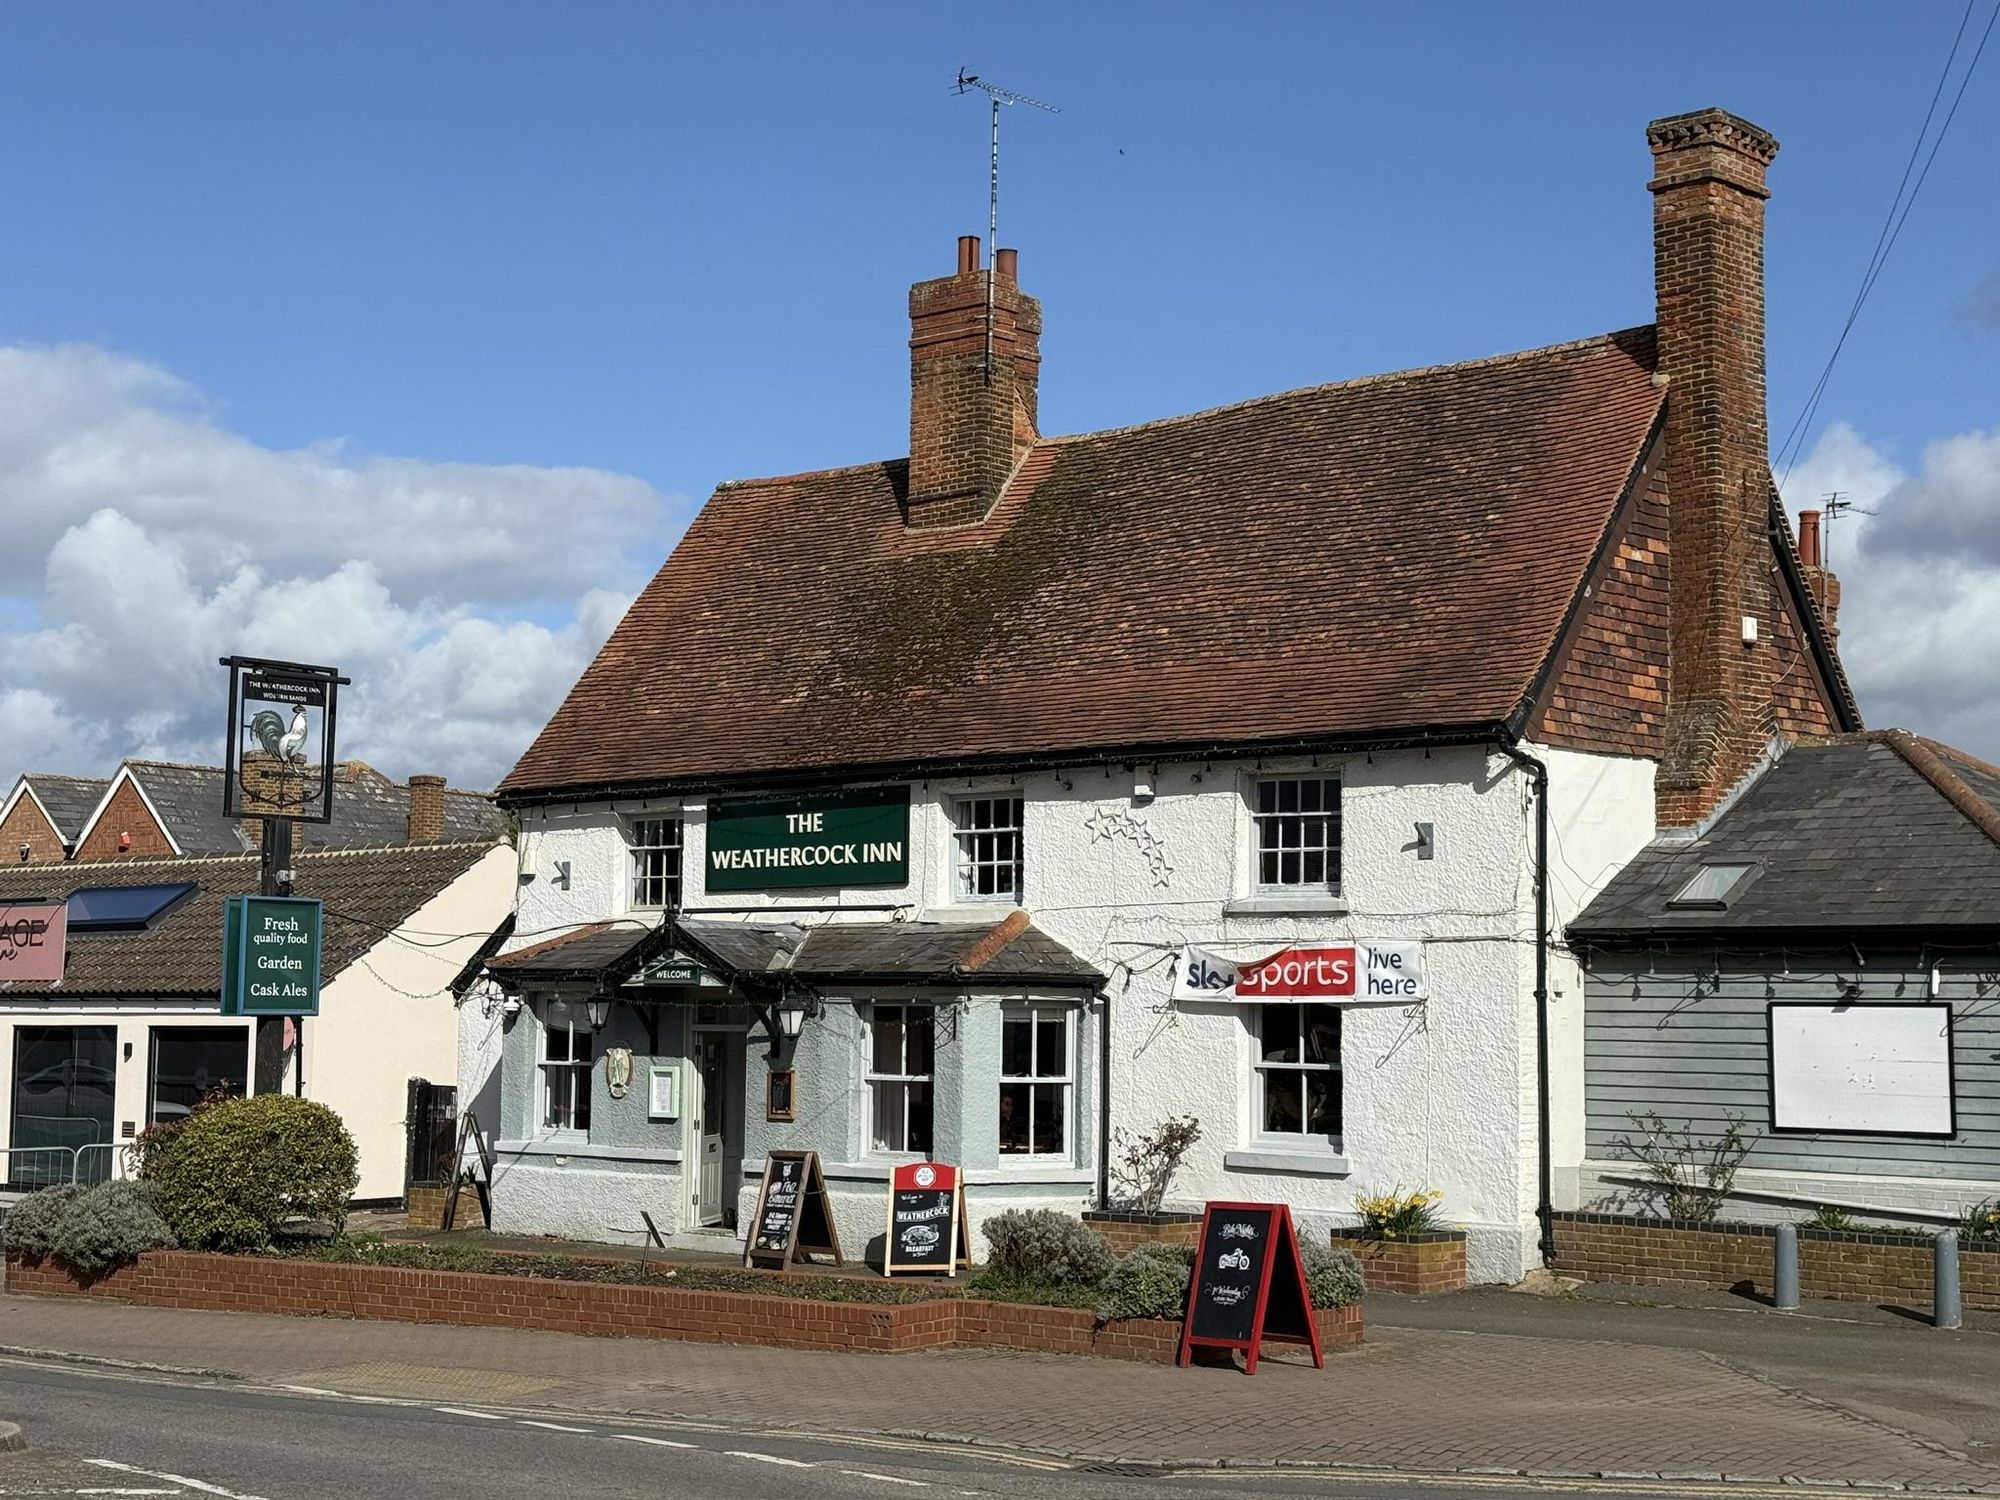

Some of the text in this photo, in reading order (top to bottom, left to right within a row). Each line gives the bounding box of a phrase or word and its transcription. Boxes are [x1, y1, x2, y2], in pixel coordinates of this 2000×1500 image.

[785, 812, 824, 834] THE
[711, 841, 902, 870] WEATHERCOCK INN
[264, 916, 299, 931] Fresh
[253, 932, 308, 945] quality food
[257, 955, 302, 970] Garden
[1367, 947, 1402, 970] live
[656, 970, 692, 979] WELCOME
[1186, 956, 1349, 993] sky sports
[250, 982, 308, 997] Cask Ales
[1367, 975, 1417, 995] here
